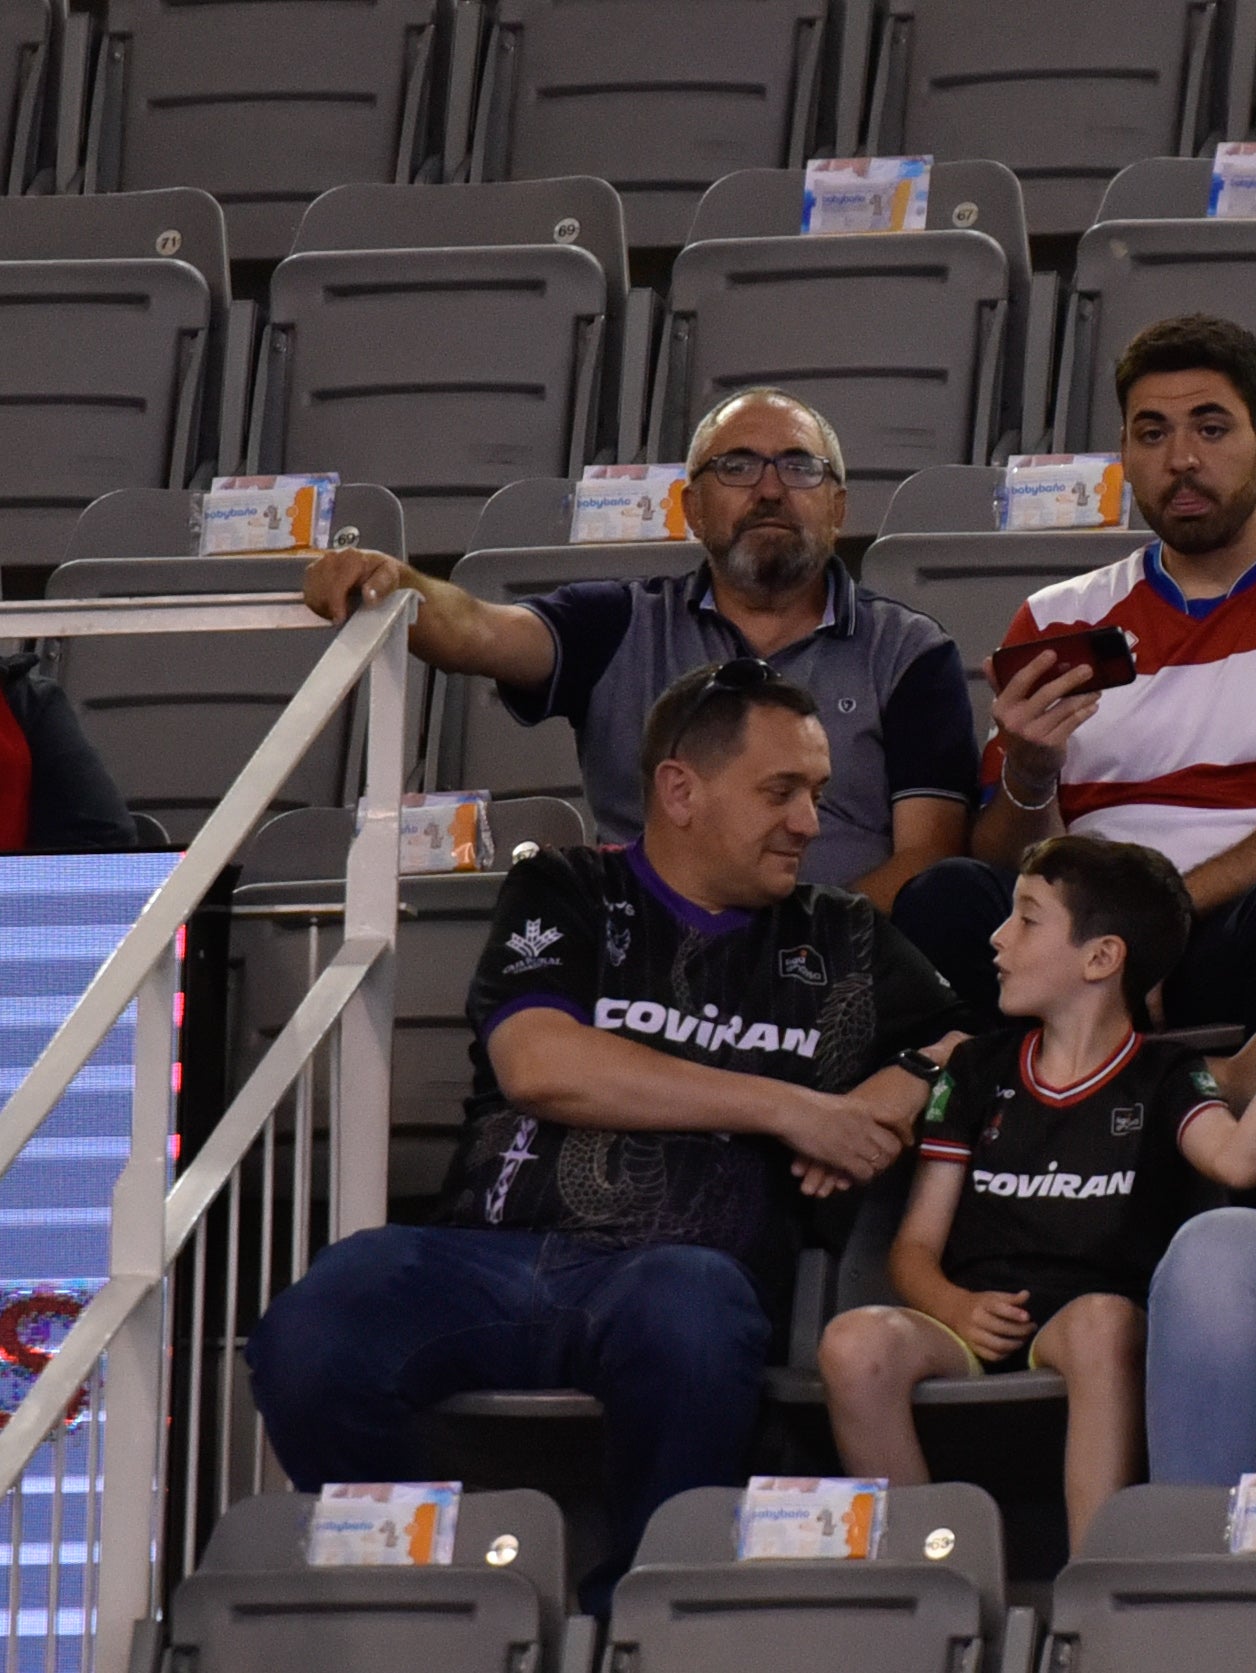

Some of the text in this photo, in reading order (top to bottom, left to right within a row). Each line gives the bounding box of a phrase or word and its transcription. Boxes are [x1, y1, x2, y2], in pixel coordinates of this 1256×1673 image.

[957, 209, 974, 221] 67
[558, 224, 575, 237] 69
[162, 236, 176, 250] 71
